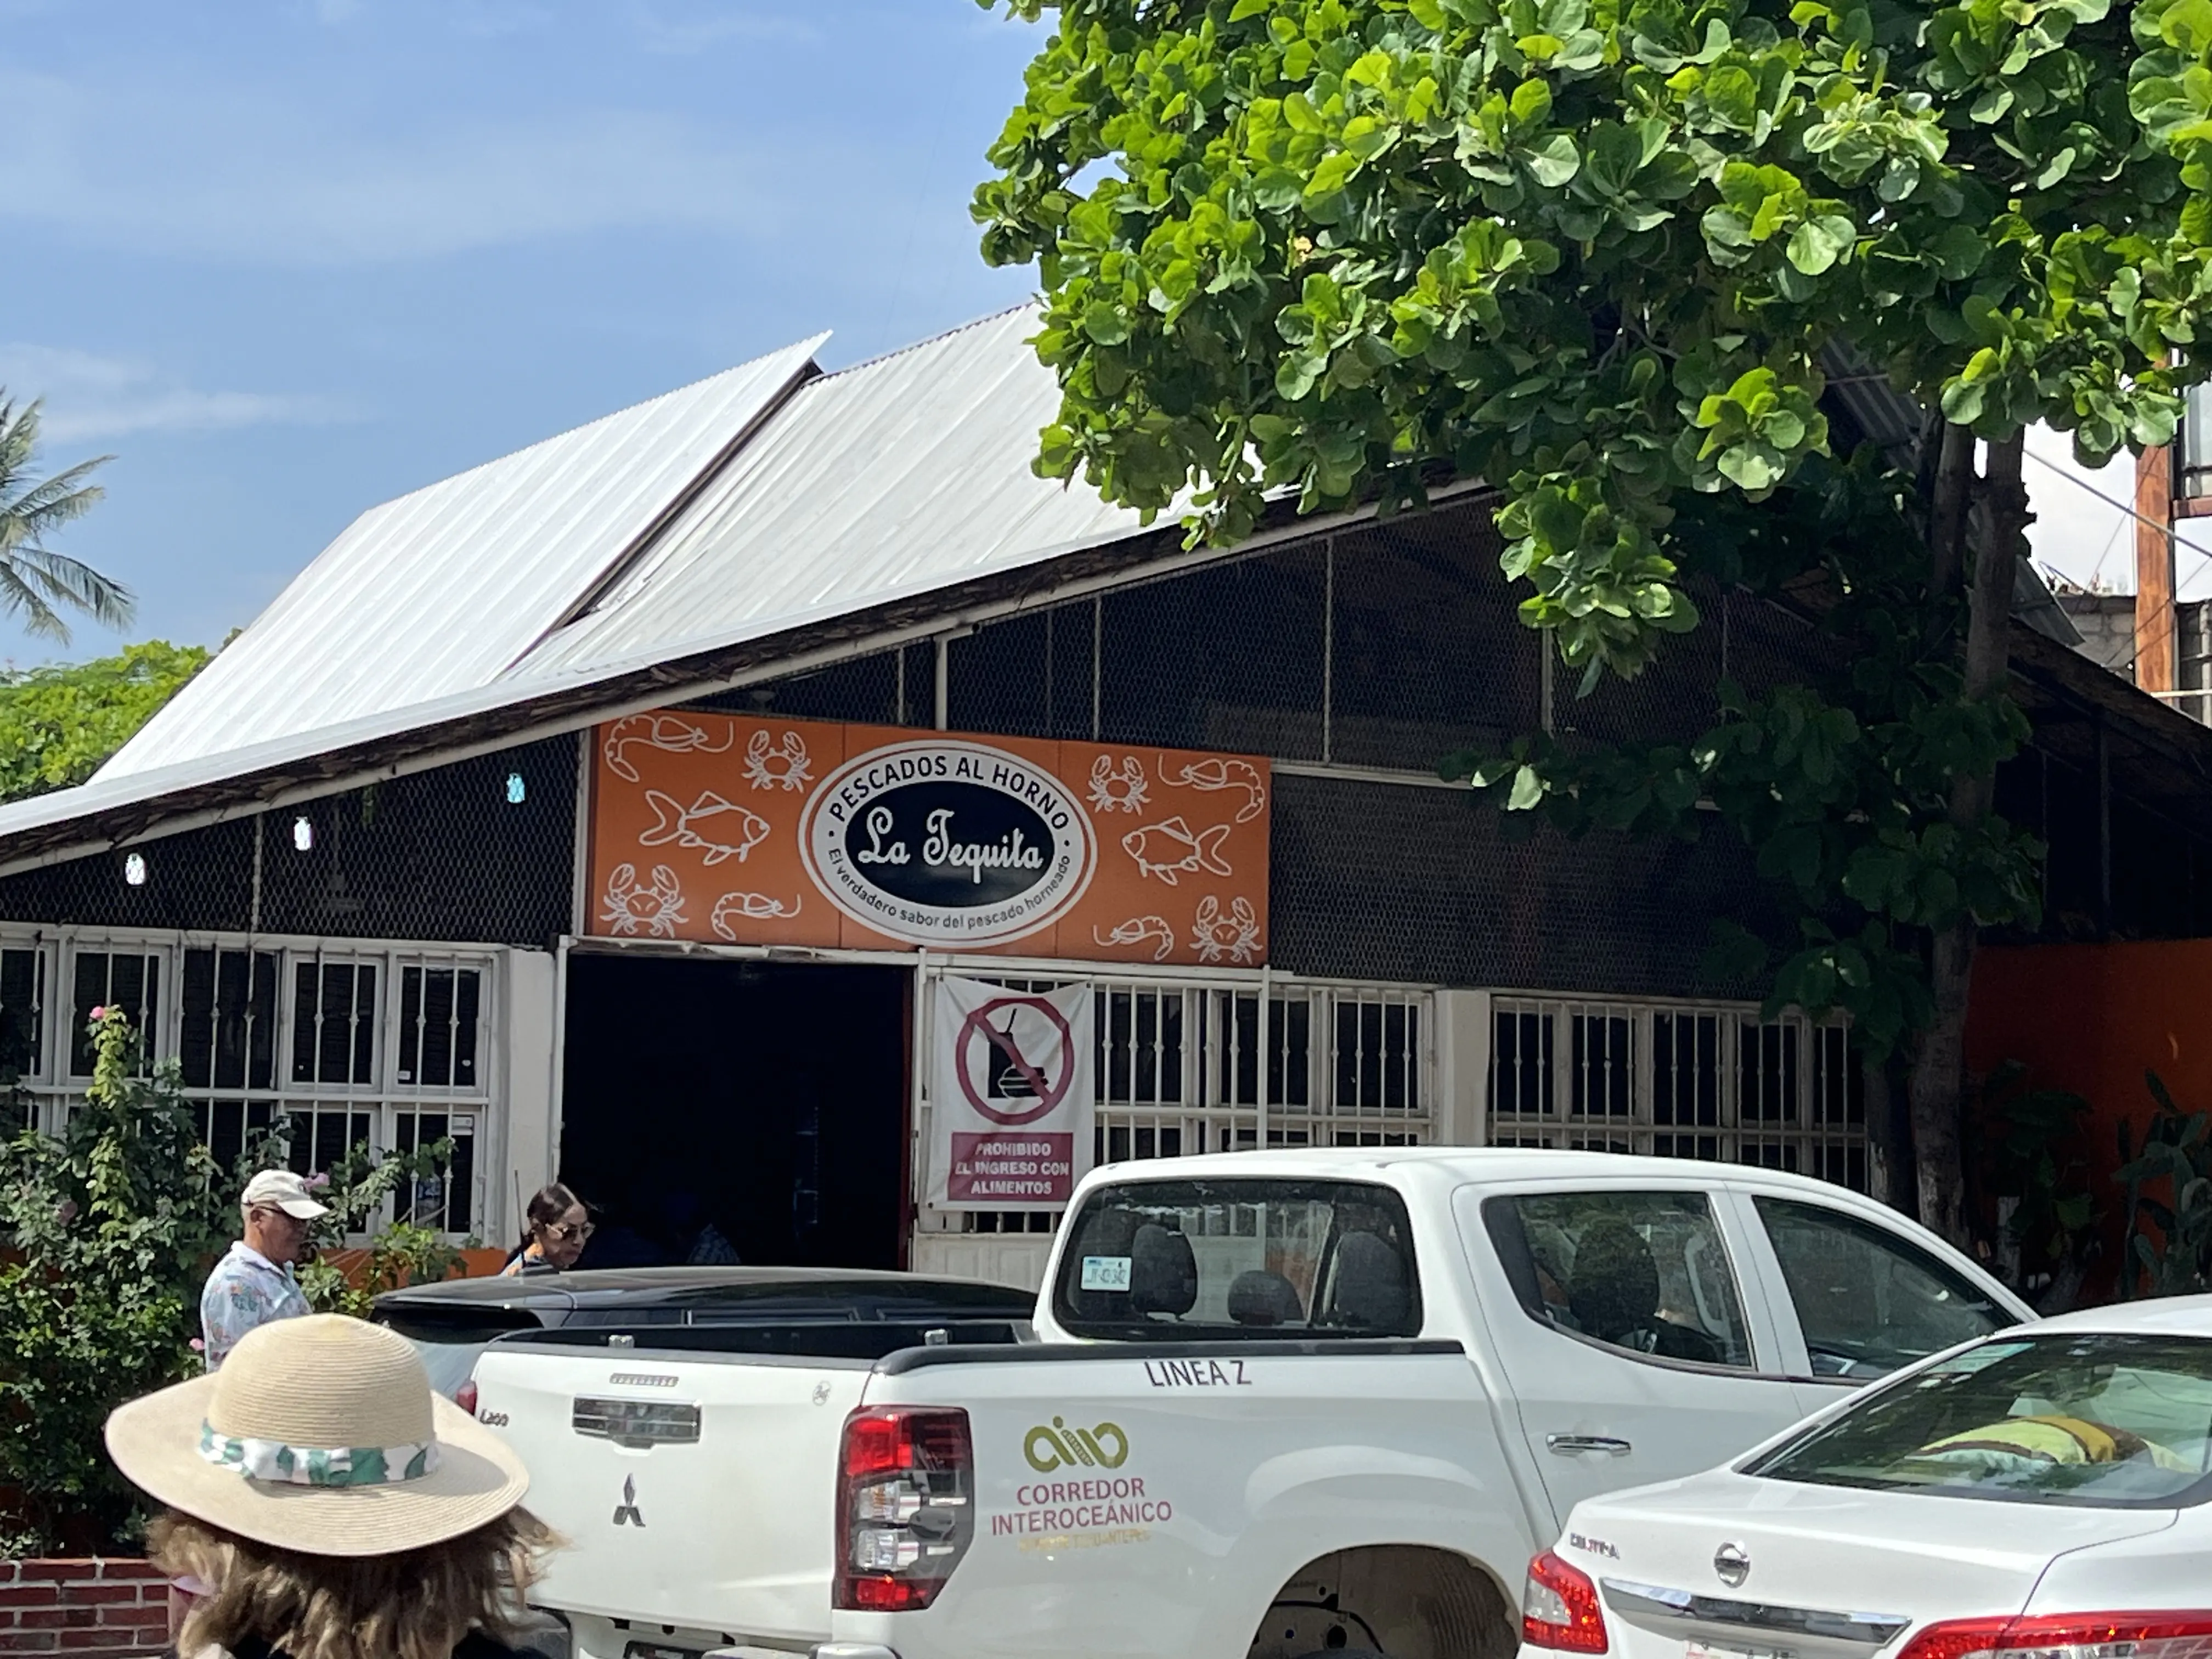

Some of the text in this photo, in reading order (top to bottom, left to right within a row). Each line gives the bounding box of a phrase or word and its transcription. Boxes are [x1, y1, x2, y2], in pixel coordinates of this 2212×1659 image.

[829, 755, 1069, 830] PESCADOS AL HORNO
[858, 806, 911, 865] La
[828, 848, 1070, 930] El verdadero sabor del pescado horneado
[975, 1142, 1051, 1157] PROHIBIDO
[955, 1161, 1069, 1176] EL INGRESO CON
[970, 1180, 1052, 1195] ALIMENTOS
[1144, 1359, 1252, 1387] LINEA Z
[1017, 1477, 1145, 1506] CORREDOR
[991, 1498, 1172, 1536] INTEROCEÁNICO
